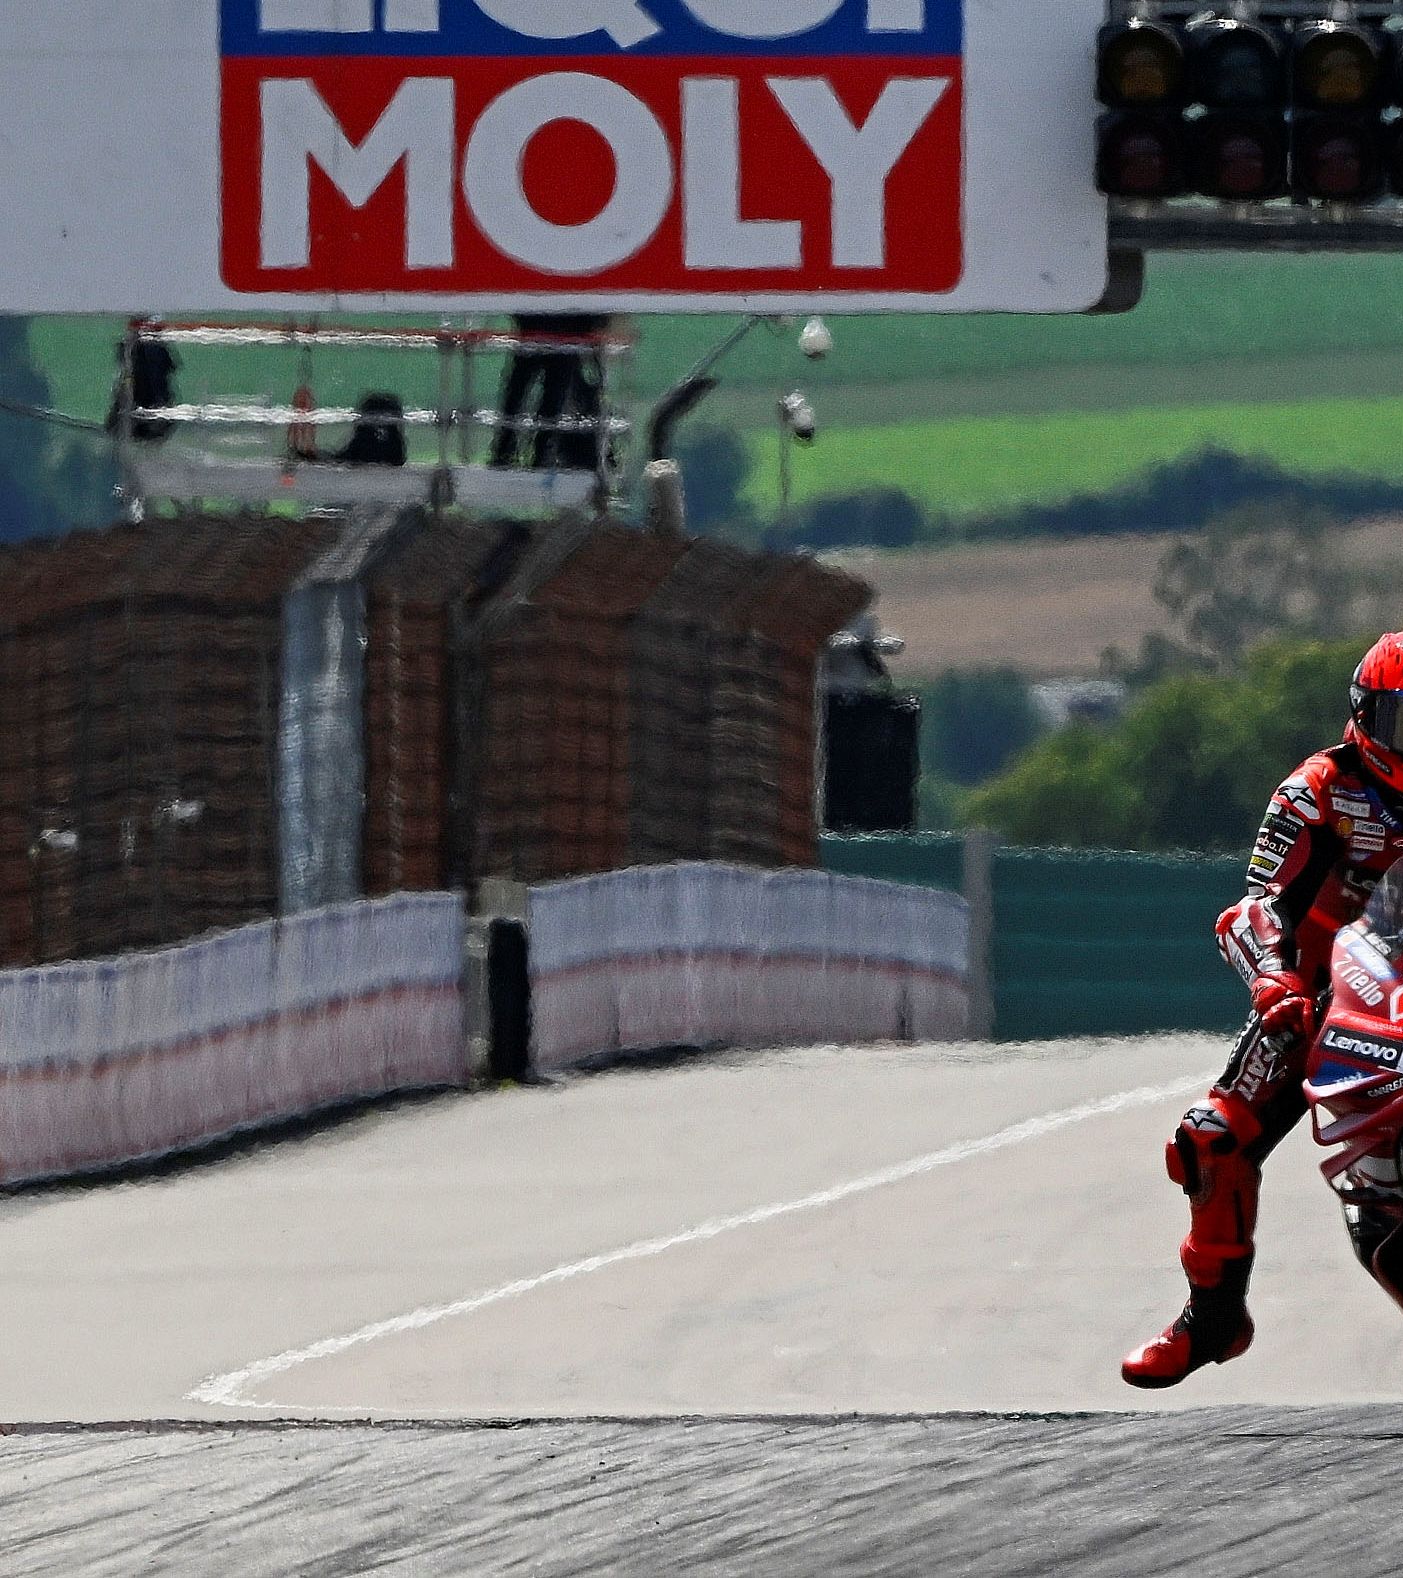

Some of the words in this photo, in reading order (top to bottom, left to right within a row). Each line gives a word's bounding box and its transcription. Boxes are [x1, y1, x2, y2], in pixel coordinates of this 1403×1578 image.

[258, 69, 952, 276] MOLY
[1380, 809, 1399, 827] TIM
[1340, 964, 1385, 1007] riello
[1324, 1029, 1398, 1061] Lenovo
